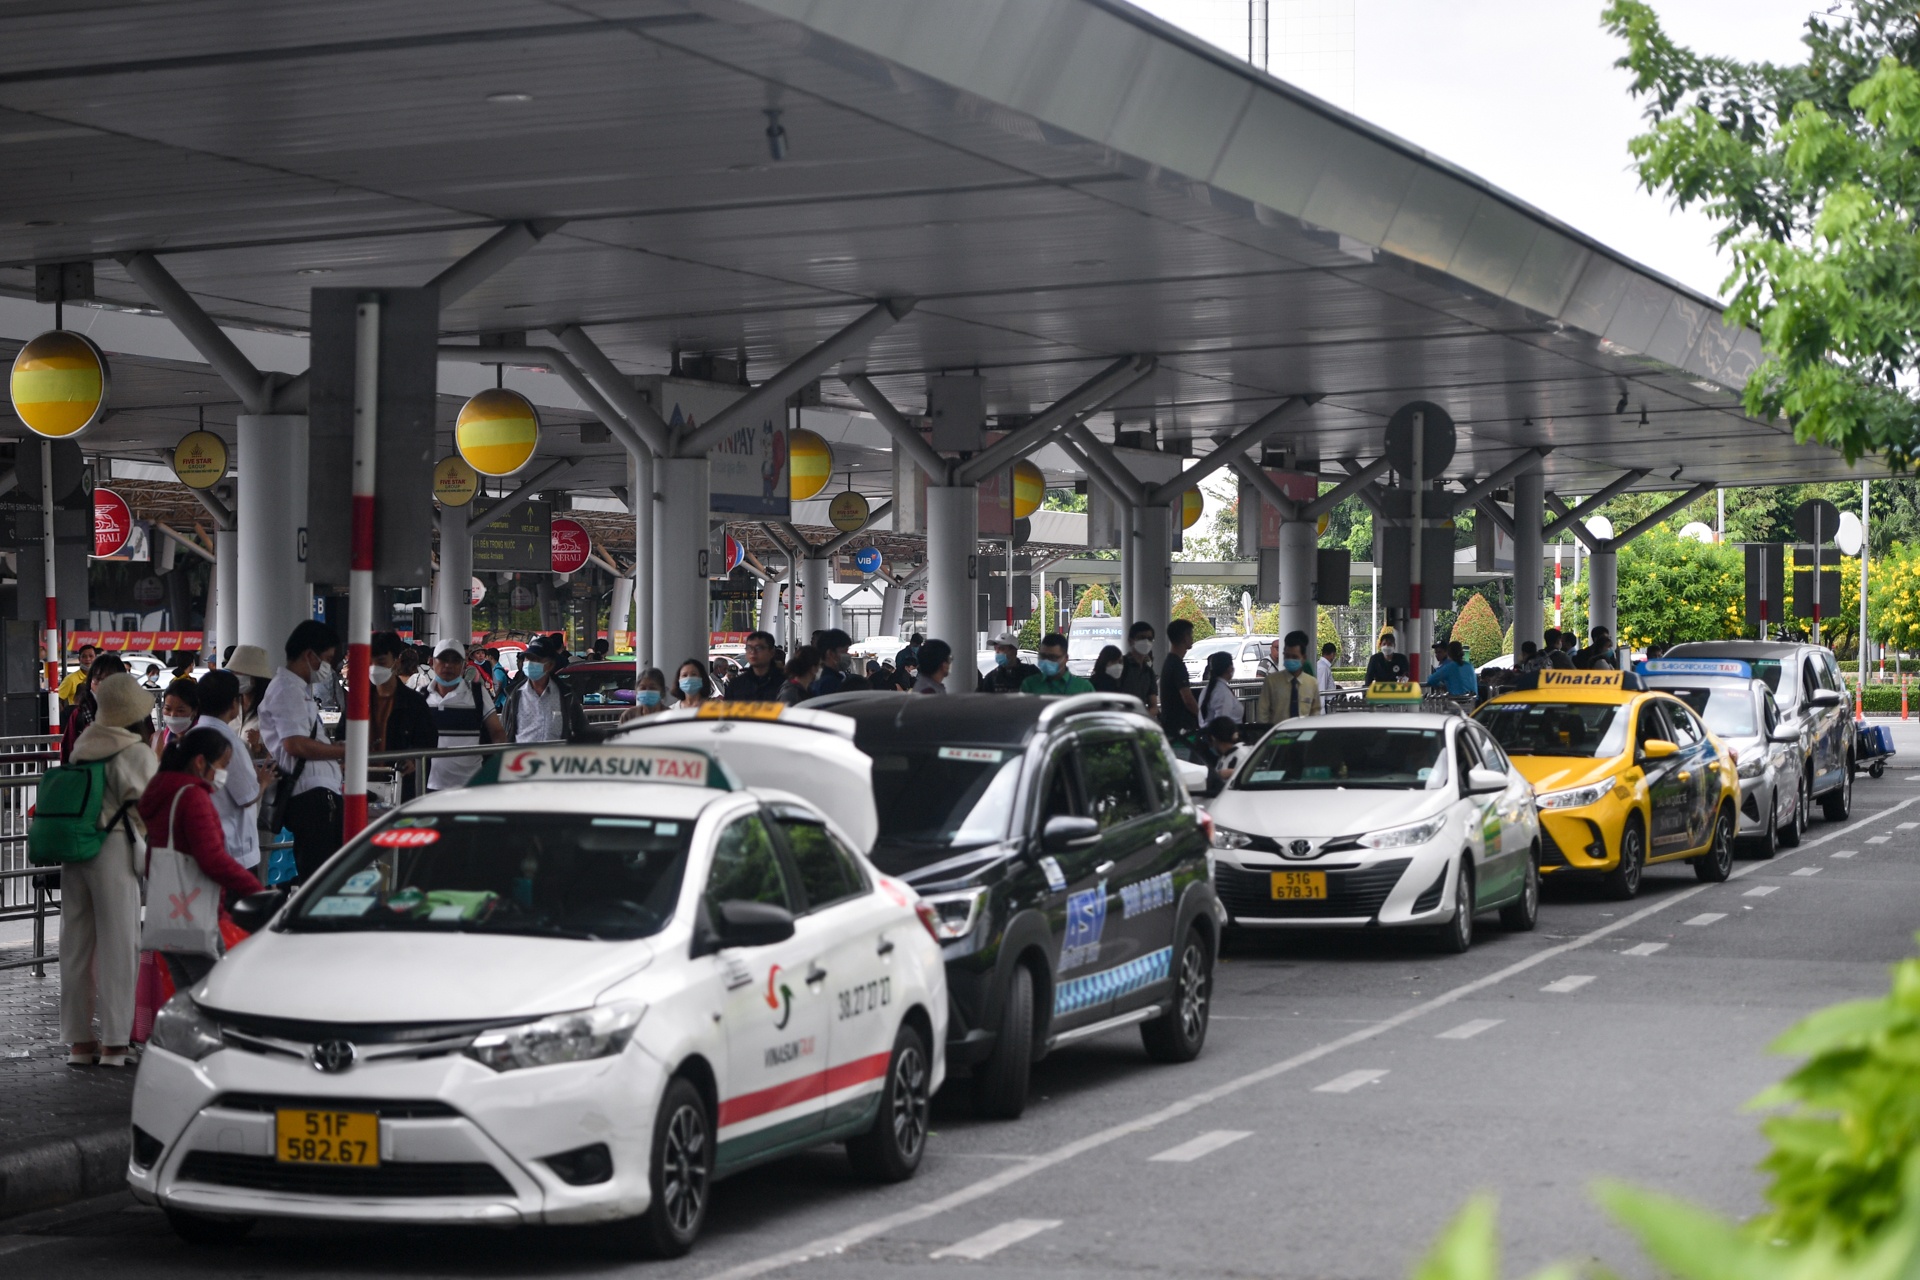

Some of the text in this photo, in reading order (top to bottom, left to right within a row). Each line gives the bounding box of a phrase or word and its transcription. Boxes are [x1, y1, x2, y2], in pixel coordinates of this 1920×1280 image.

[857, 557, 872, 565] VIB
[1661, 662, 1719, 672] SAIGONTOURIST
[1544, 671, 1621, 685] Vinataxi
[550, 755, 702, 780] VINASUN TAXI
[1286, 872, 1311, 885] 51G
[1277, 885, 1320, 899] 678.31
[305, 1111, 350, 1137] 51F
[287, 1137, 368, 1163] 582.67
